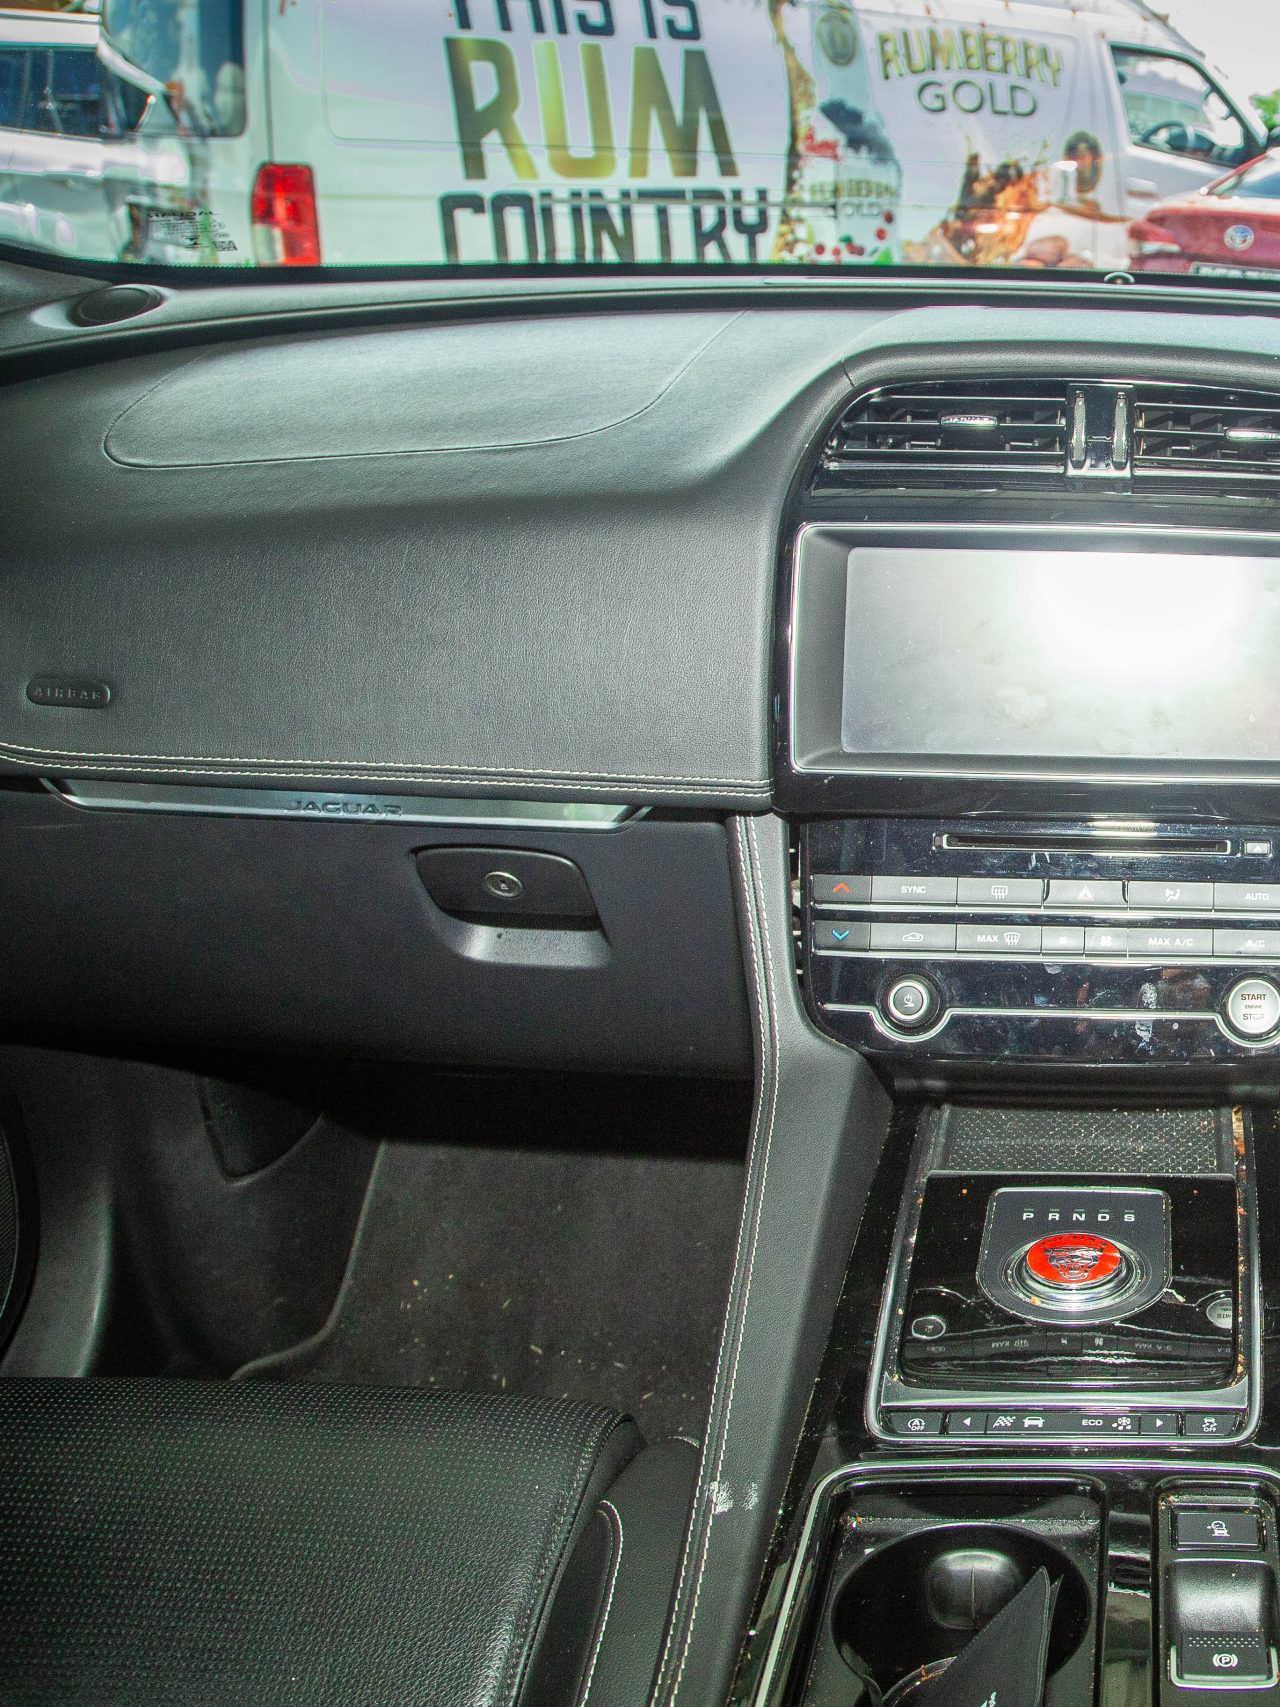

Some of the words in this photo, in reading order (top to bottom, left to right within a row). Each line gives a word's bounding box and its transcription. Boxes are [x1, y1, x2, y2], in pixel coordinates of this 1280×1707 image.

[877, 27, 1062, 87] RUMBERRY
[916, 78, 1038, 117] GOLD
[442, 36, 740, 181] RUM
[440, 188, 768, 264] COUNTRY
[283, 800, 402, 817] JAGUAR
[901, 885, 927, 895] SYNC
[1245, 892, 1269, 901] AUTO
[977, 934, 999, 943] MAX
[1149, 937, 1170, 946] MAX
[1175, 938, 1194, 947] A/C
[1246, 939, 1266, 948] A/C
[1240, 993, 1267, 1001] START
[1022, 1212, 1034, 1221] P
[1048, 1212, 1060, 1221] R
[1072, 1213, 1086, 1221] N
[1097, 1213, 1110, 1222] D
[1124, 1213, 1135, 1222] S
